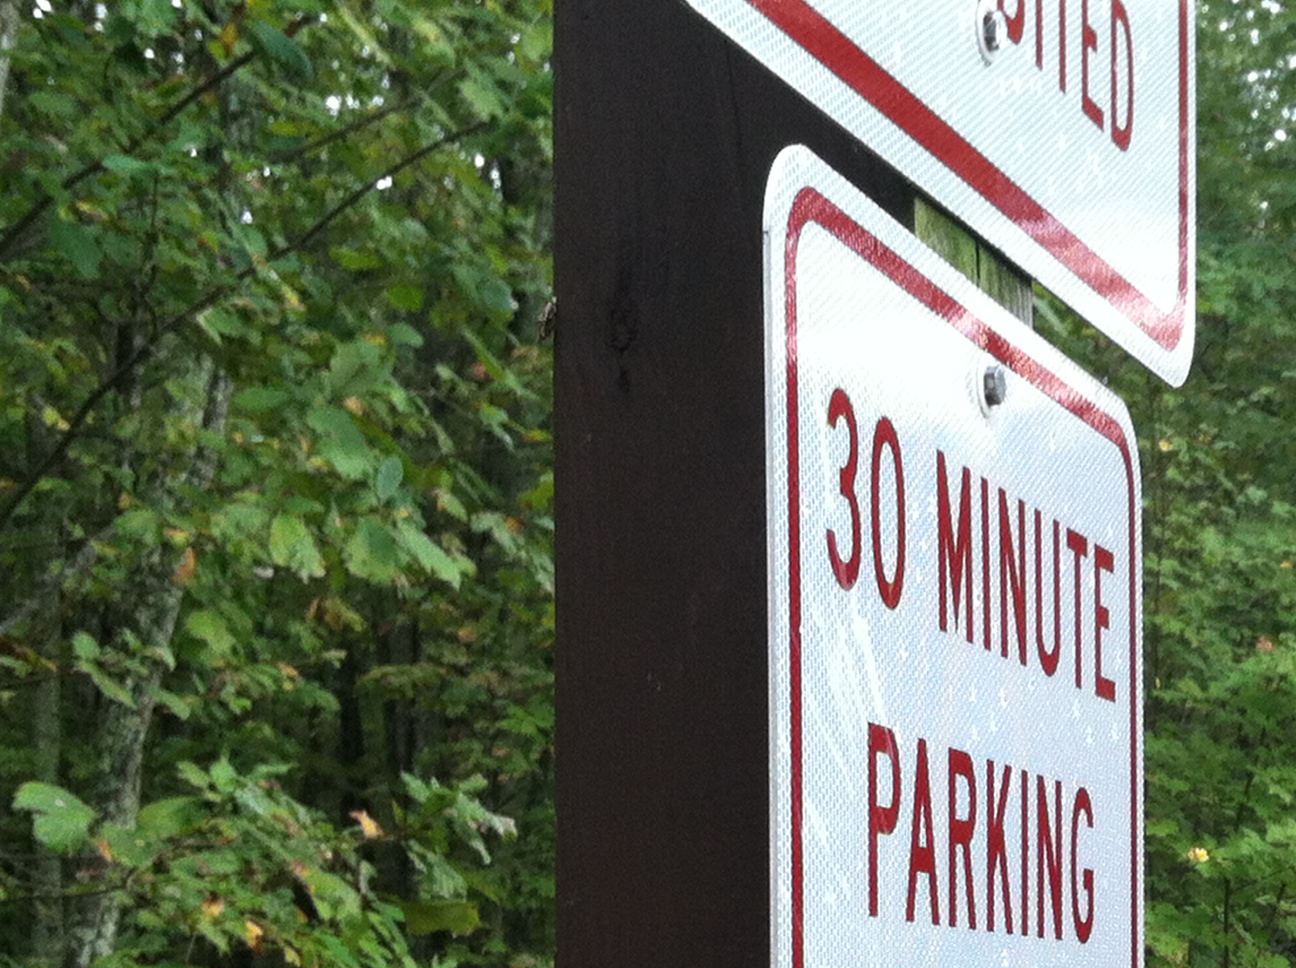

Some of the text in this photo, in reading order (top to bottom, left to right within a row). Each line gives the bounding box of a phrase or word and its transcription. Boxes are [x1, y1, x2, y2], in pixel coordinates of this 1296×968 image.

[826, 387, 1117, 703] 30 MINUTE
[867, 721, 1095, 944] PARKING
